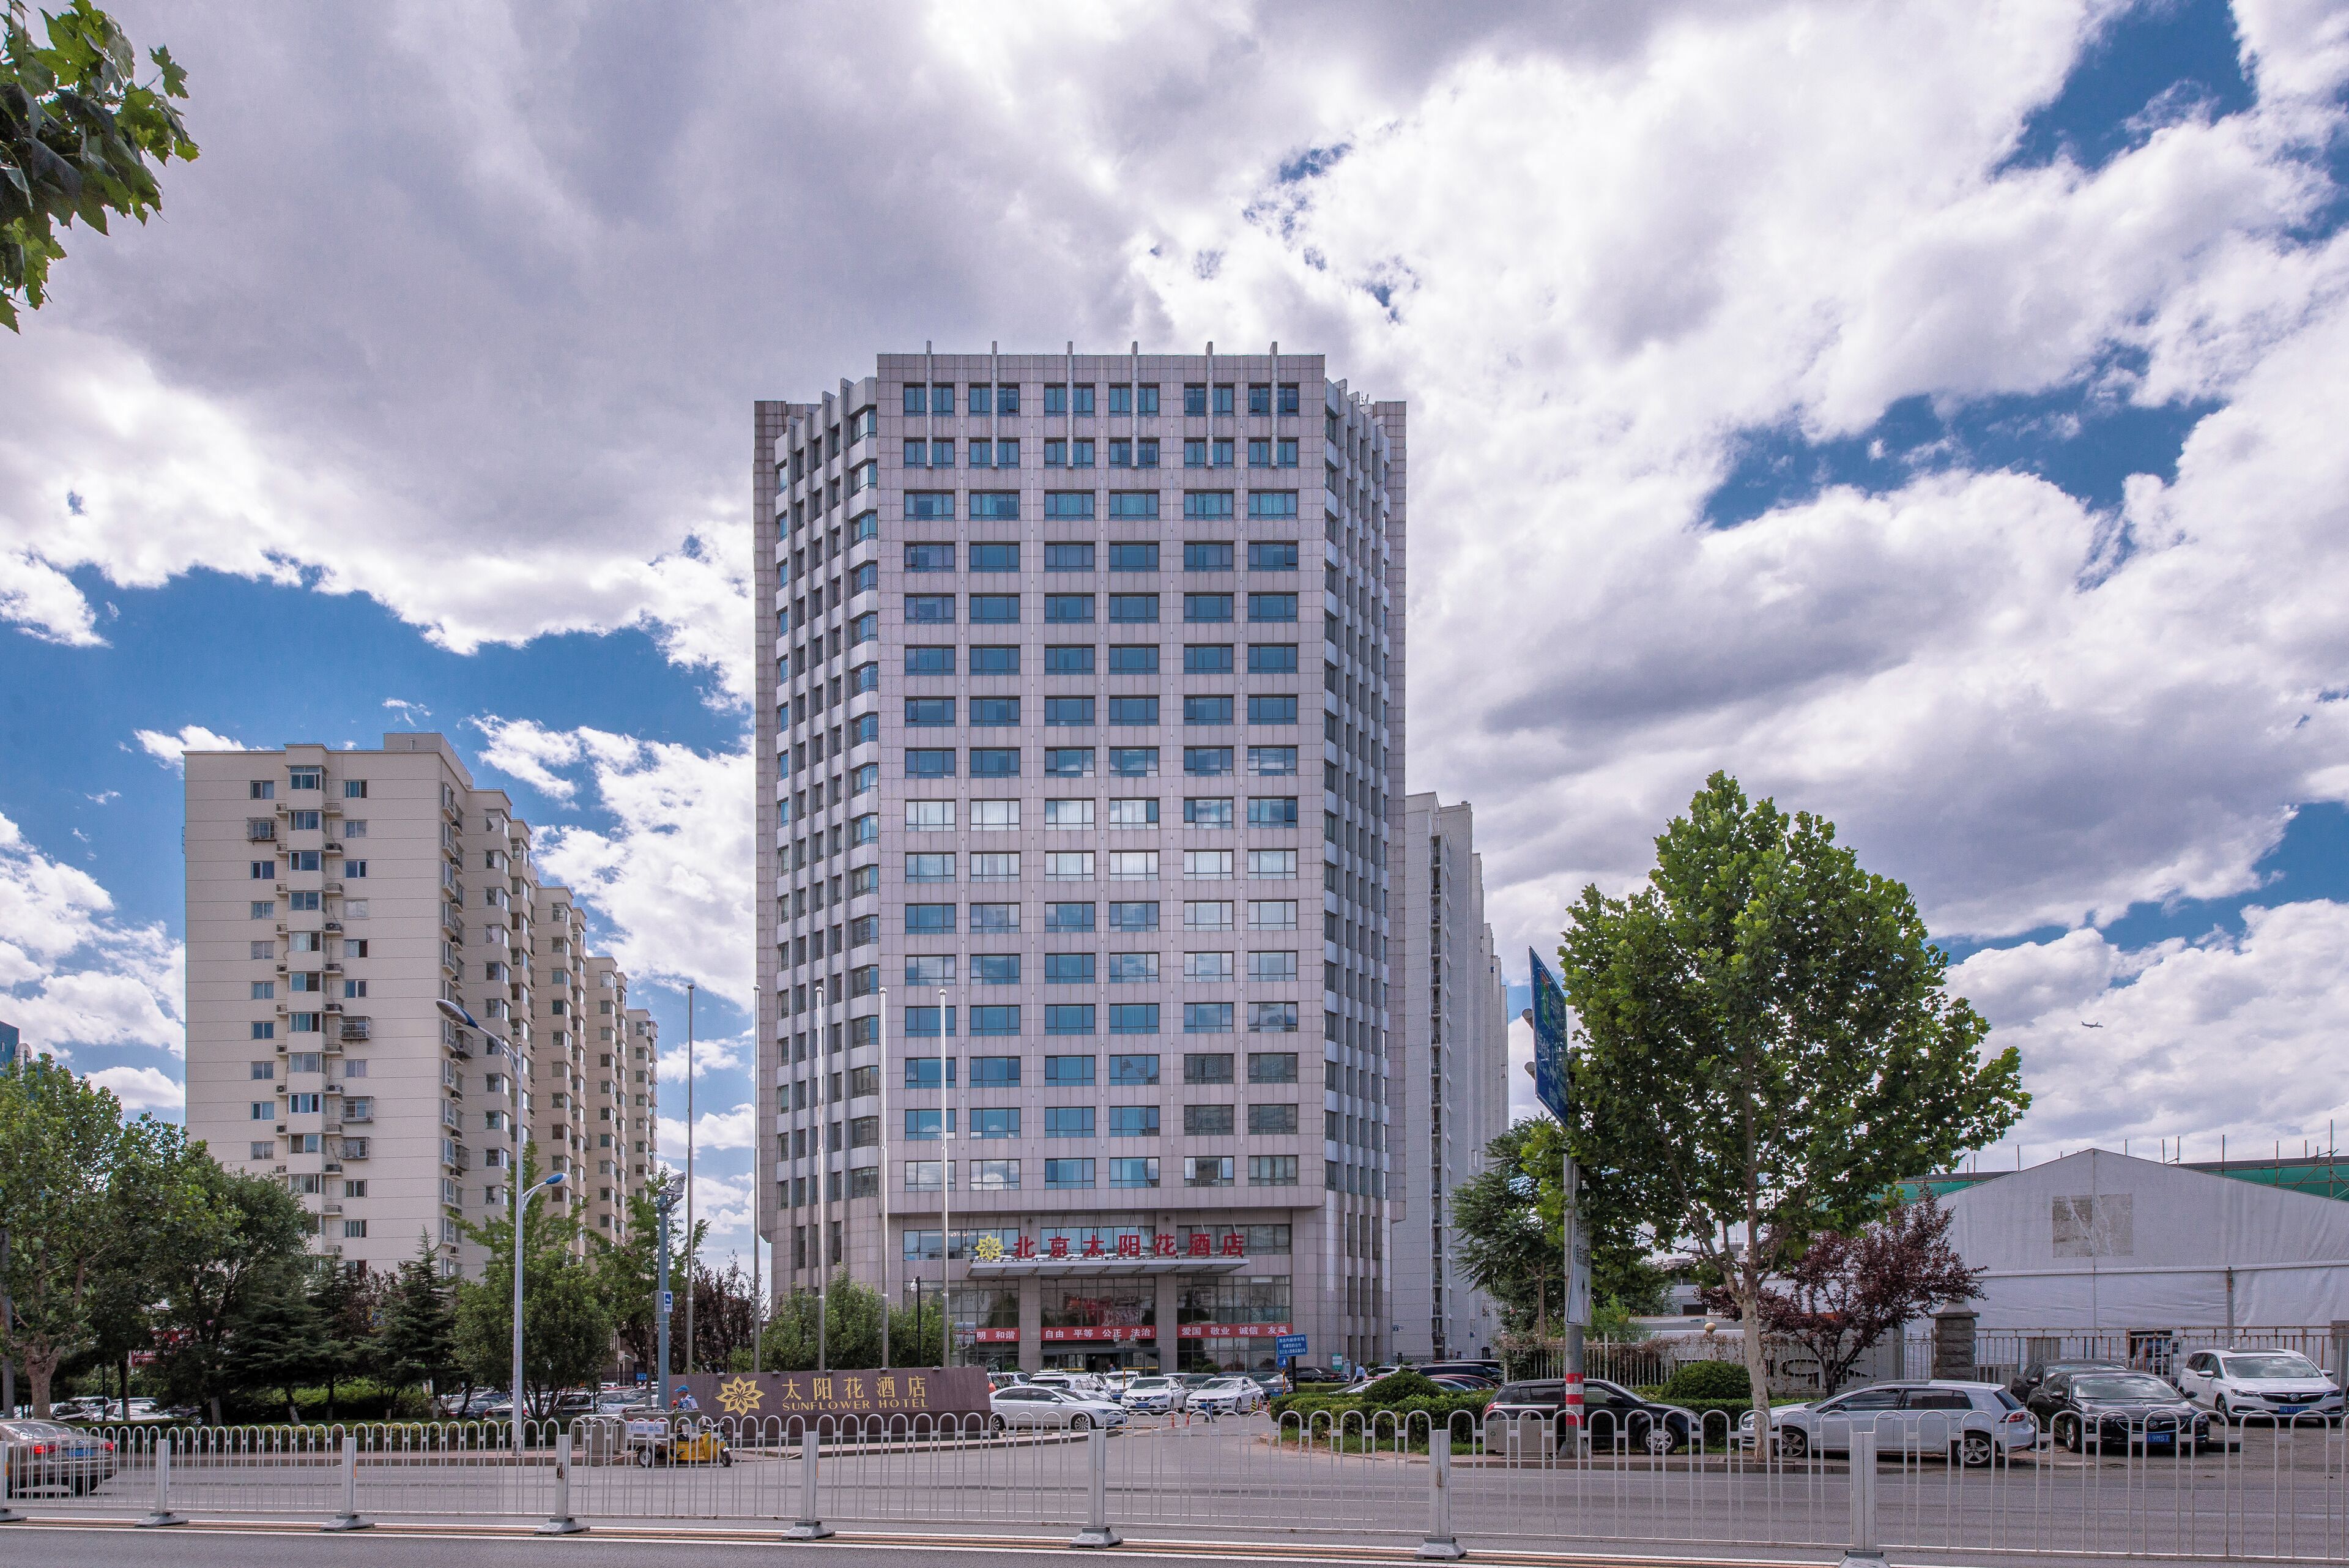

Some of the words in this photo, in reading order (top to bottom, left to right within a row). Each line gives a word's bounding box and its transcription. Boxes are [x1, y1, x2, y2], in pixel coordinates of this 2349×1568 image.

[1012, 1233, 1244, 1258] 北京太阳花酒店
[977, 1331, 986, 1340] 明
[995, 1331, 1015, 1340] 和谐
[1045, 1329, 1064, 1339] 自由
[1074, 1329, 1094, 1339] 平等
[1102, 1329, 1123, 1337] 公正
[1131, 1328, 1151, 1337] 法治
[1182, 1327, 1201, 1336] 爱国
[1210, 1326, 1230, 1336] 敬业
[1239, 1326, 1259, 1335] 诚信
[1267, 1326, 1288, 1335] 友善
[782, 1375, 926, 1401] 太阳花酒店
[782, 1400, 870, 1411] SUNFLOWER
[879, 1398, 929, 1408] HOTEL
